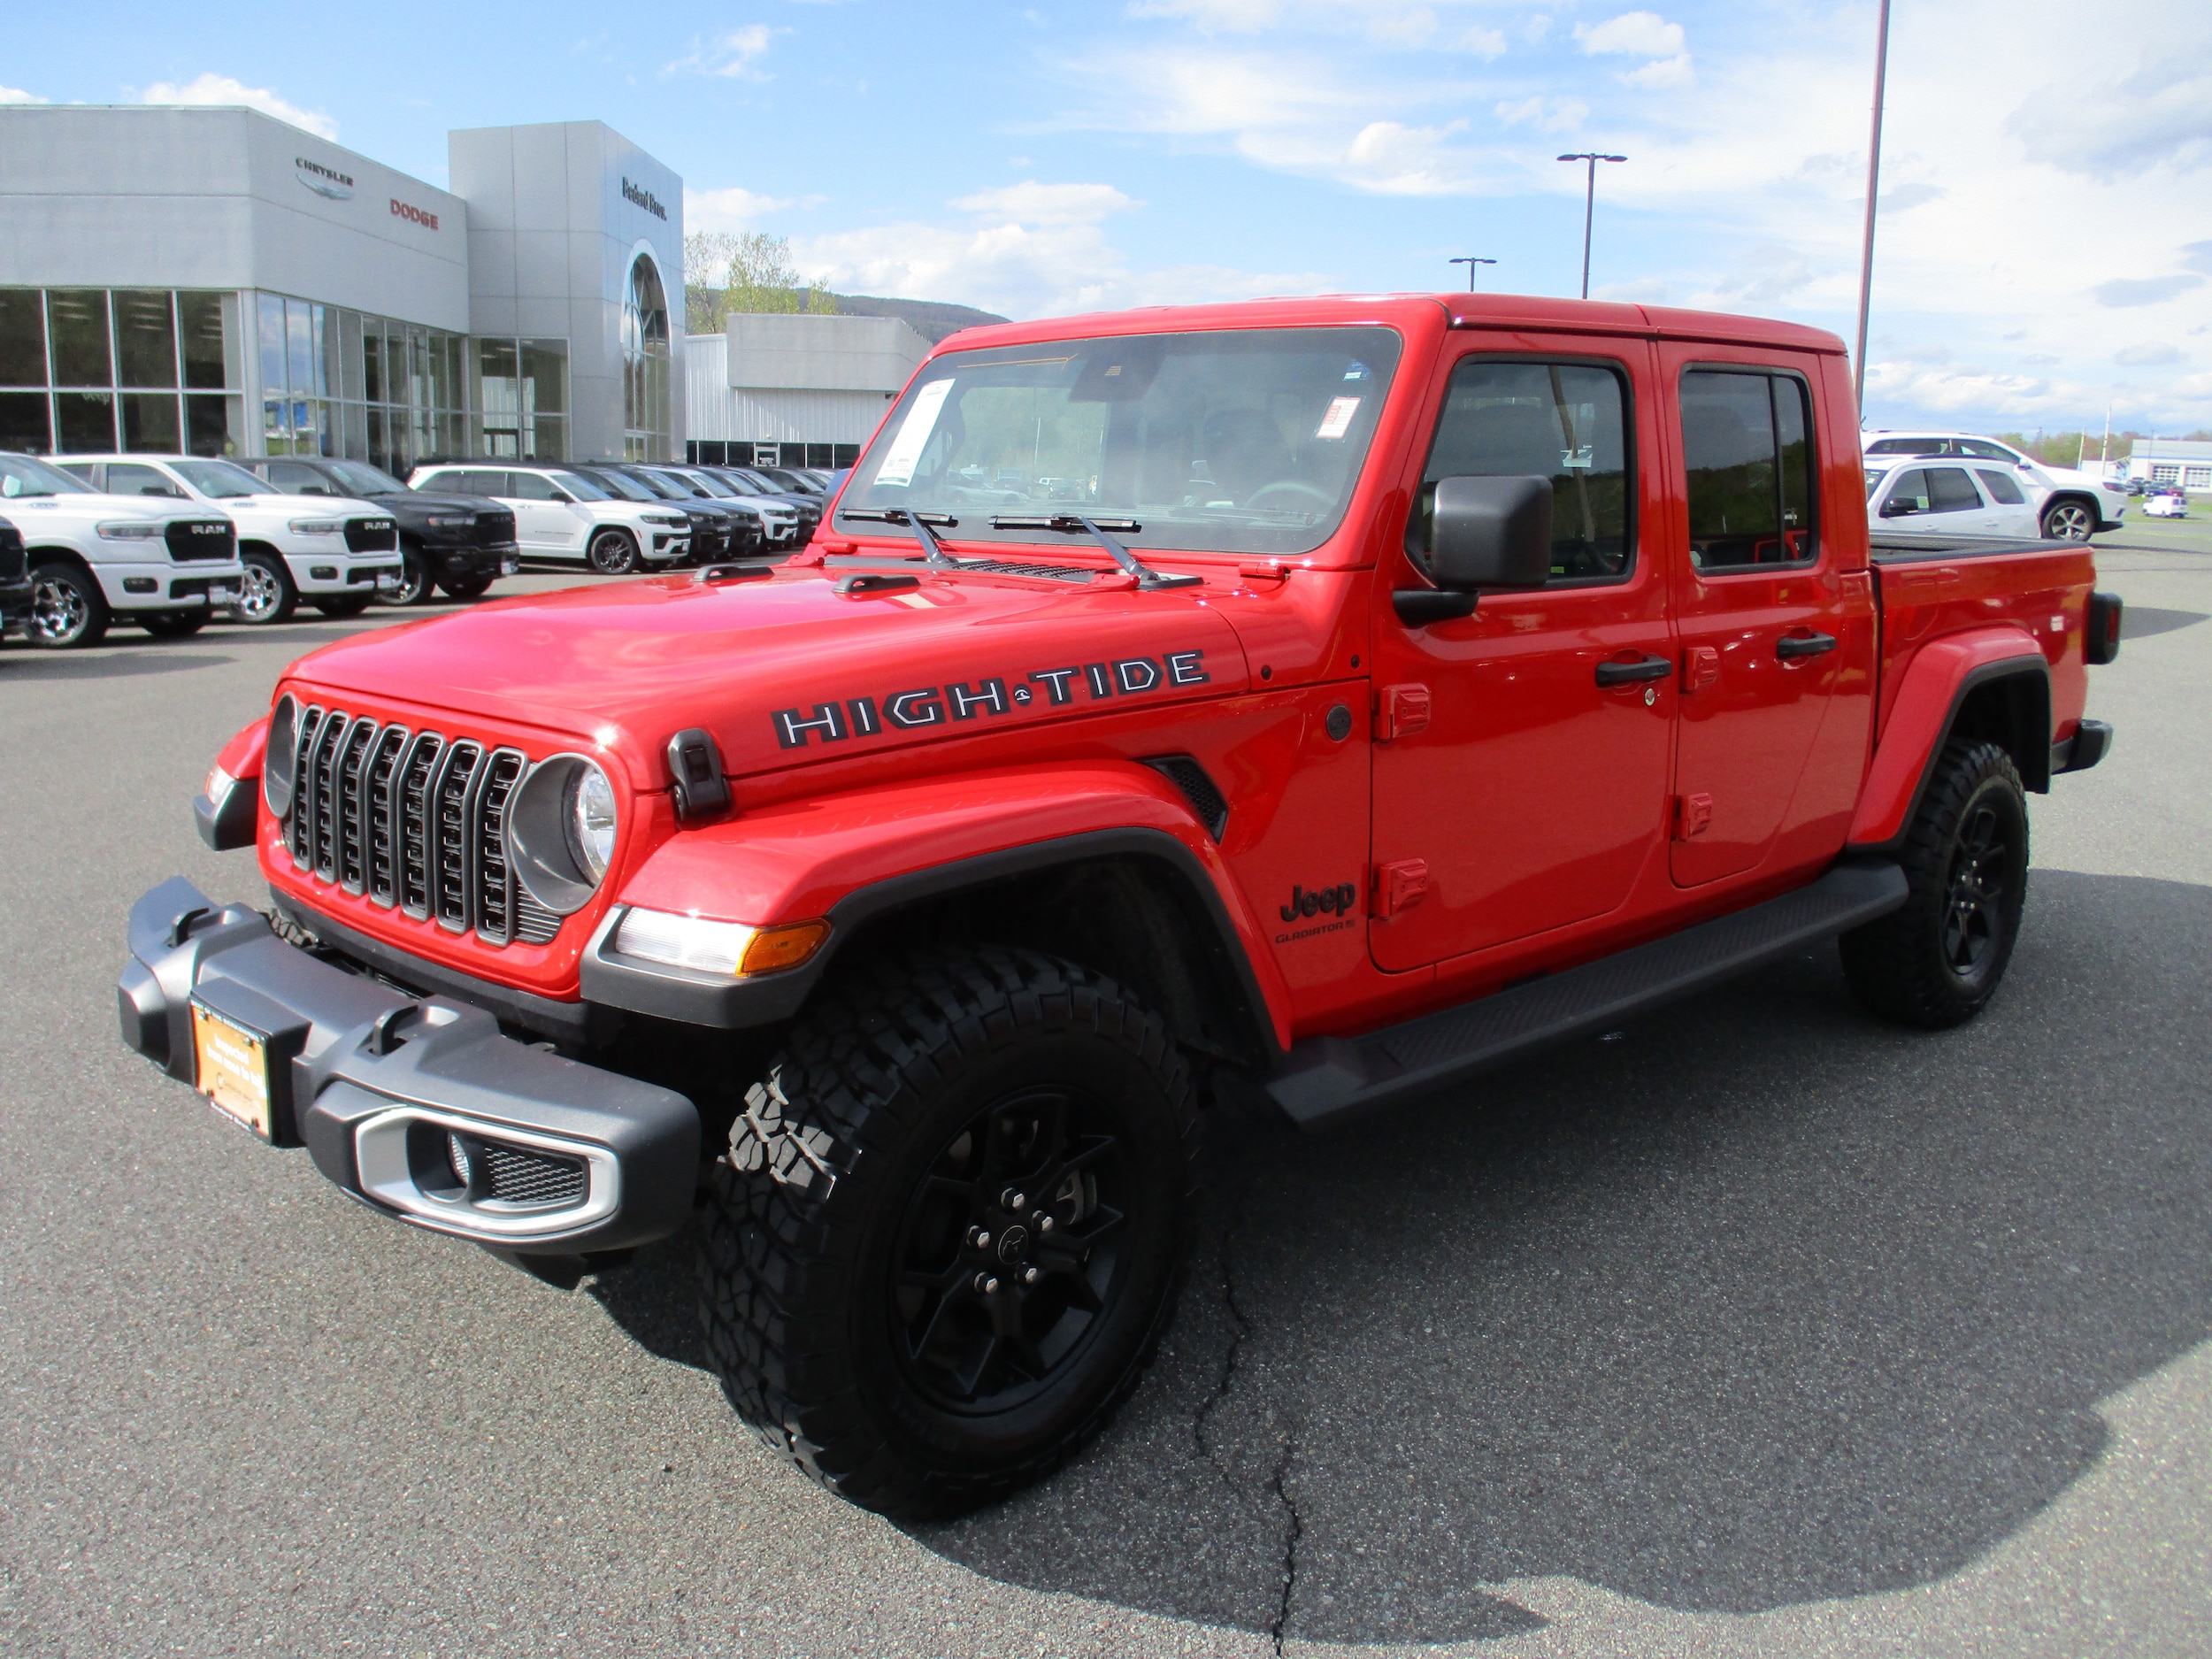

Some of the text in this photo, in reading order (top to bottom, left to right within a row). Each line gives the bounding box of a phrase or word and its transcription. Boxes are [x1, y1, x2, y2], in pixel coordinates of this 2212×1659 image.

[295, 156, 354, 187] CHRYSLER
[390, 198, 439, 230] DODGE
[191, 524, 227, 534] RAM
[364, 521, 390, 531] RAM
[772, 649, 1210, 749] HIGH TIDE
[1280, 882, 1356, 922] Jeep
[1275, 921, 1344, 944] GLADIATOR
